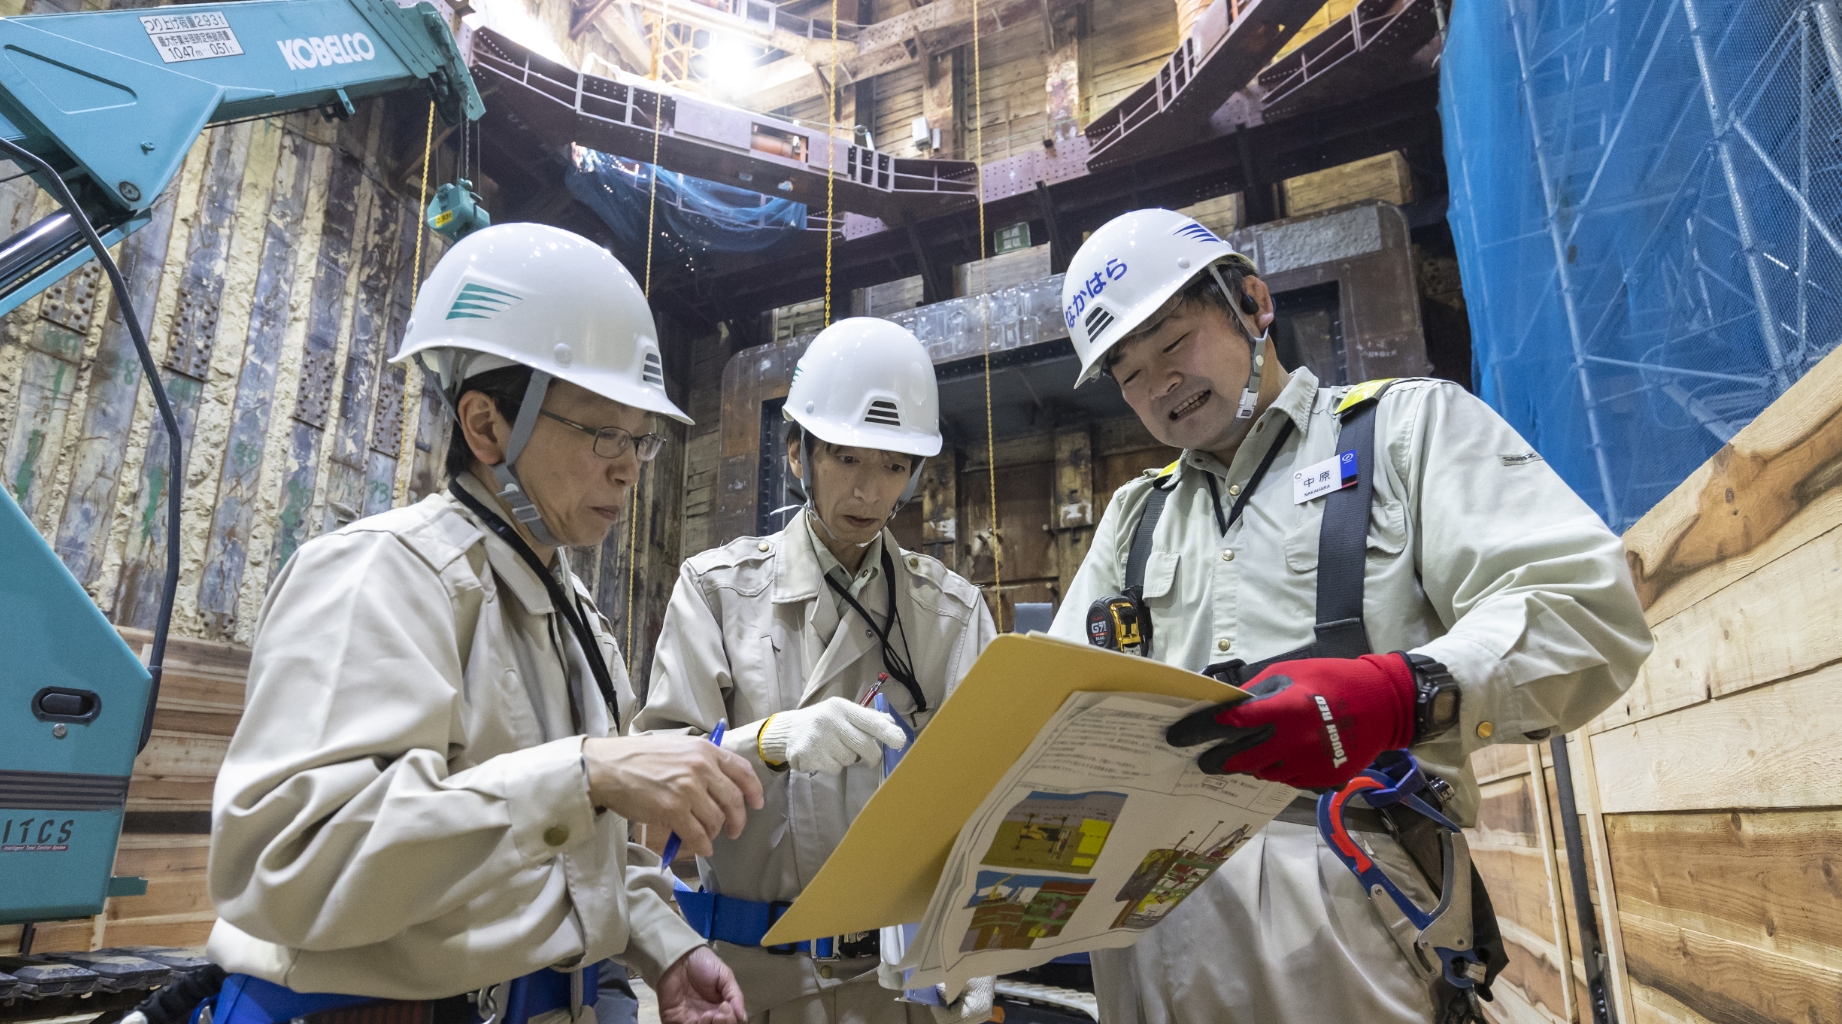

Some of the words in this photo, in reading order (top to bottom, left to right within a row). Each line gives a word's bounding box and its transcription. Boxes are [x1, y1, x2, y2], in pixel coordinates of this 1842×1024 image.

[276, 32, 375, 71] KOBELCO
[1065, 258, 1127, 328] なかはら
[2, 817, 74, 844] ITCS
